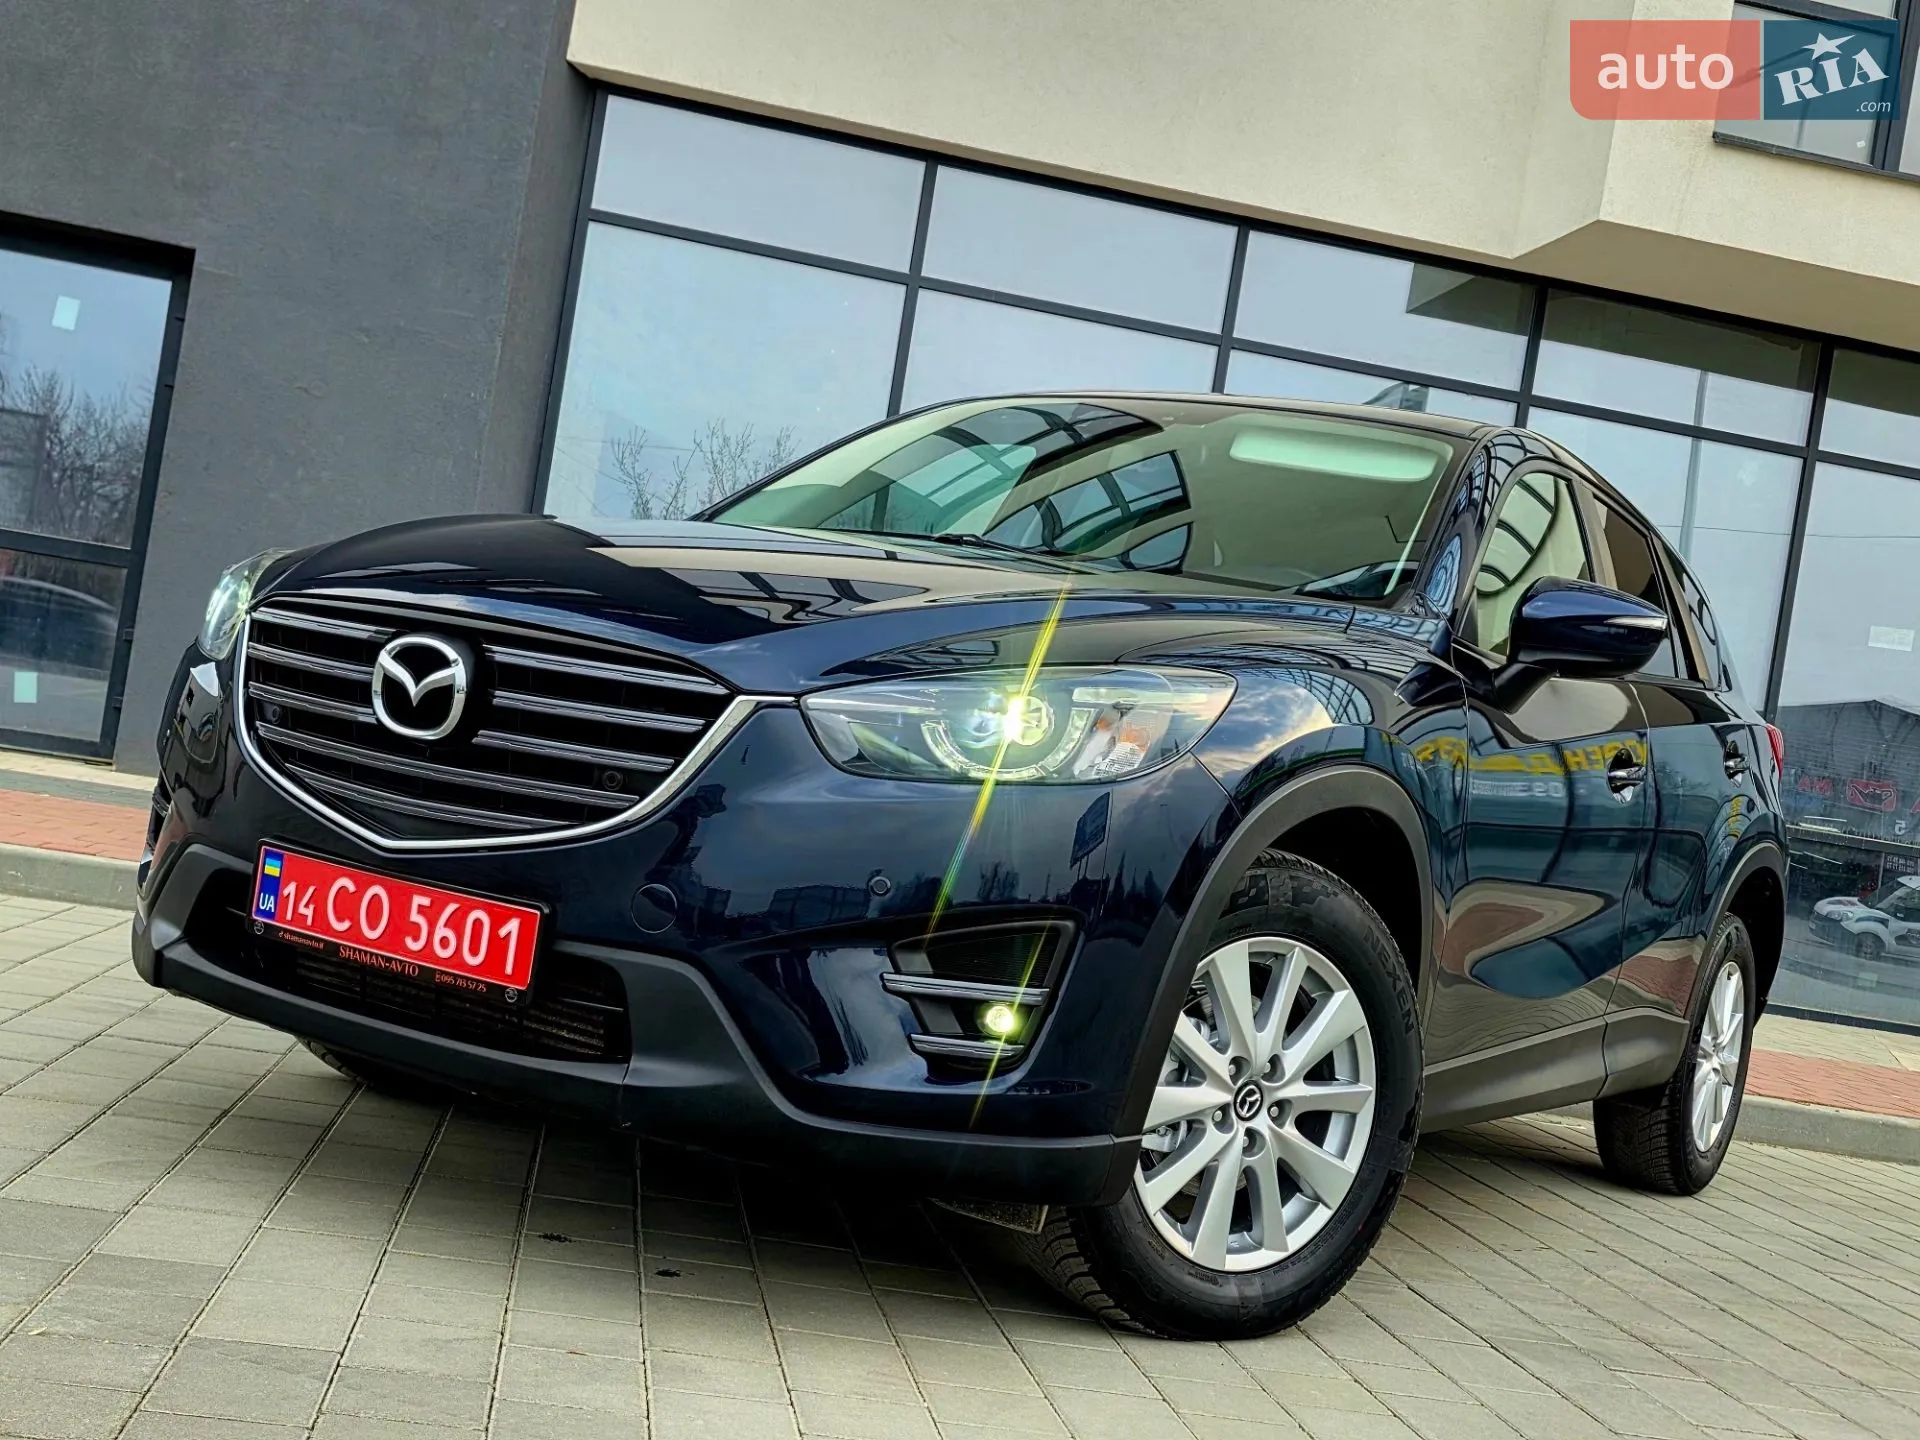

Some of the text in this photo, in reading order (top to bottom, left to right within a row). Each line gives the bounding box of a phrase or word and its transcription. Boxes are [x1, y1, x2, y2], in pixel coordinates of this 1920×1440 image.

[258, 892, 275, 913] UA
[282, 876, 522, 976] 14 CO 5601
[339, 944, 419, 978] SHAMAN-AVTO
[1363, 924, 1415, 1035] NEXEN
